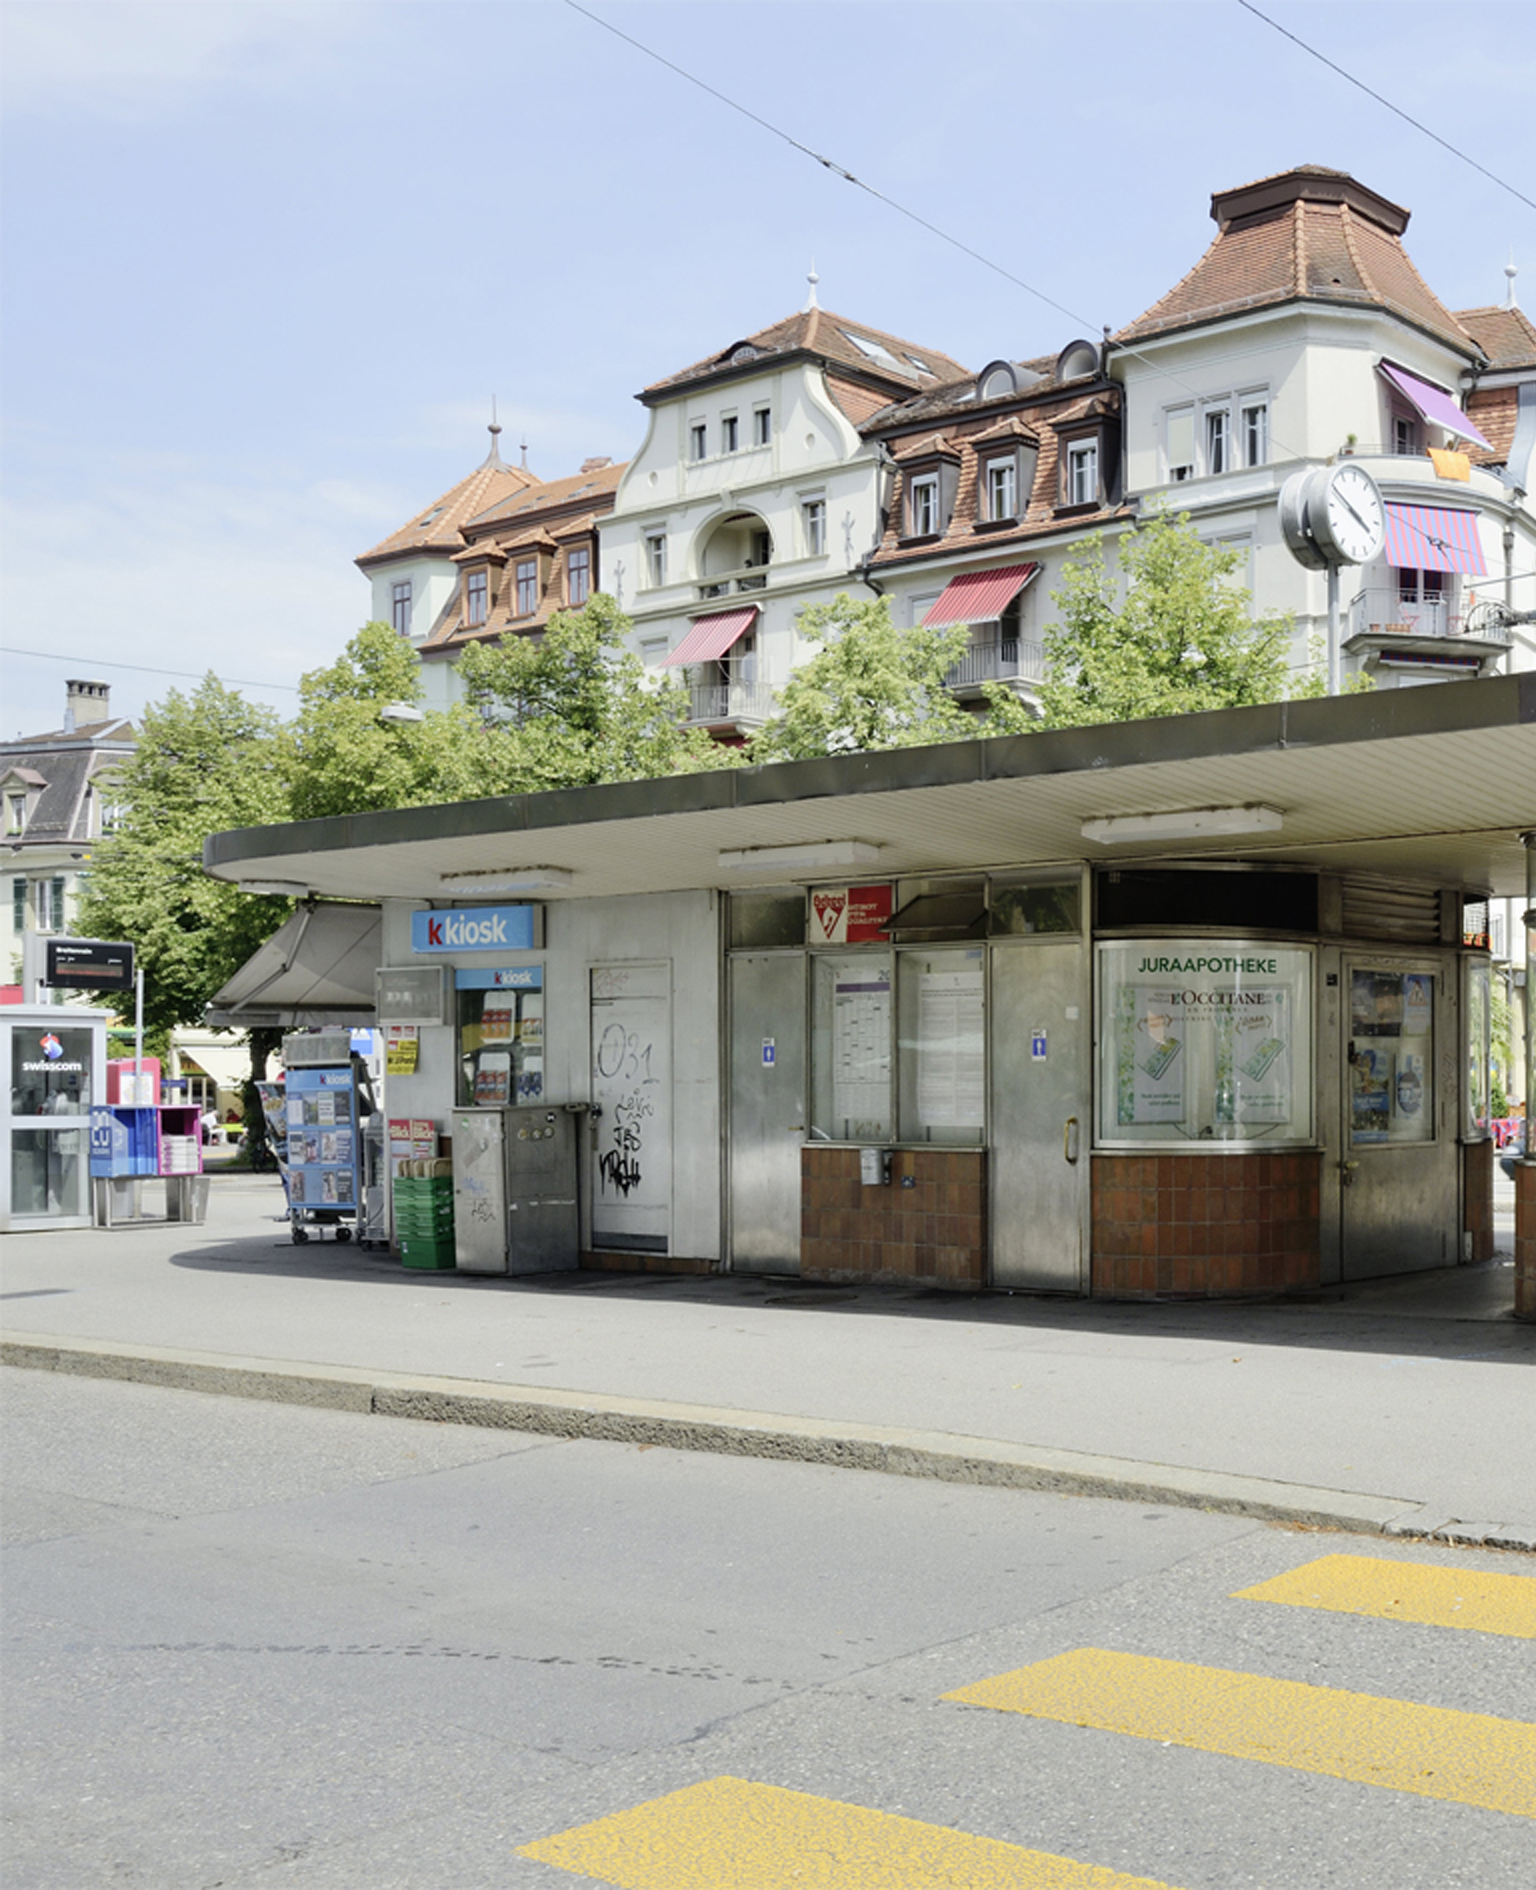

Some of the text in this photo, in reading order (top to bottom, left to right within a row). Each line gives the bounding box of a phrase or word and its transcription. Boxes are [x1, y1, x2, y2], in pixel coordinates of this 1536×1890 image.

[428, 914, 508, 945] k kiosk
[1138, 957, 1277, 974] JURAAPOTHEKE
[502, 969, 533, 985] kiosk
[22, 1059, 82, 1072] swisscom
